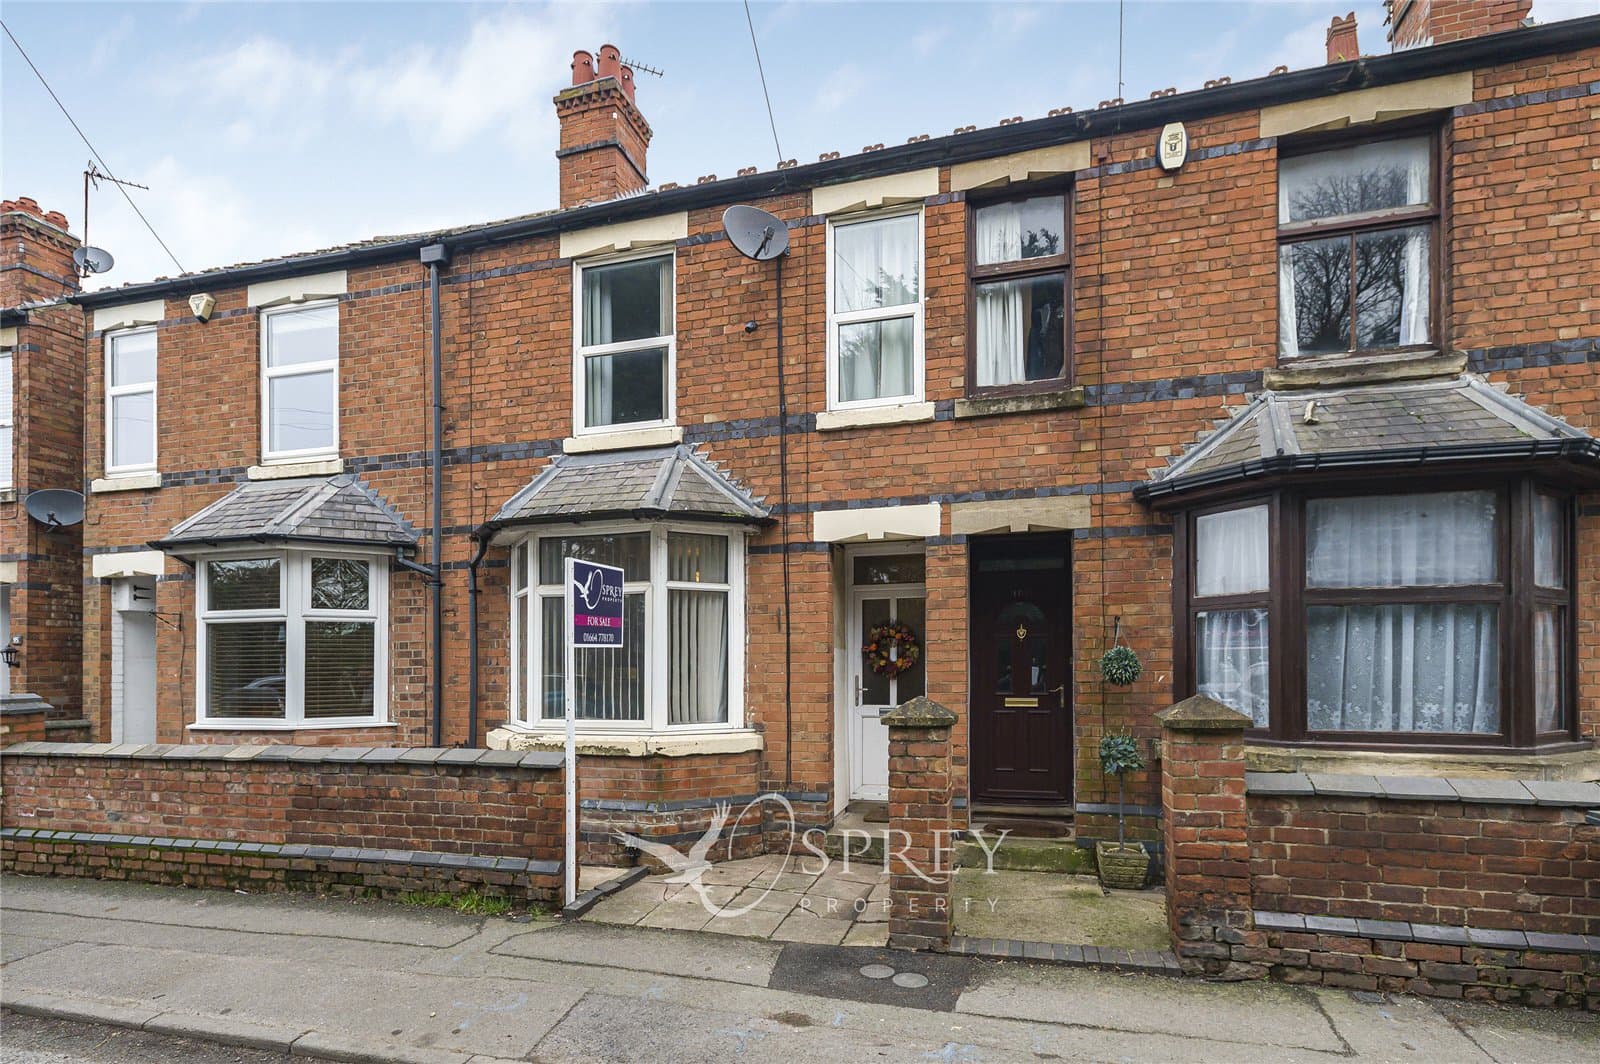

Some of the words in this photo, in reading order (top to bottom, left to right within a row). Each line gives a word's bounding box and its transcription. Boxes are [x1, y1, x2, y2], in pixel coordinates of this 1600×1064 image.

[588, 569, 622, 609] OSPREY
[587, 616, 599, 626] FOR
[599, 616, 611, 627] SALE
[583, 632, 598, 642] 01664
